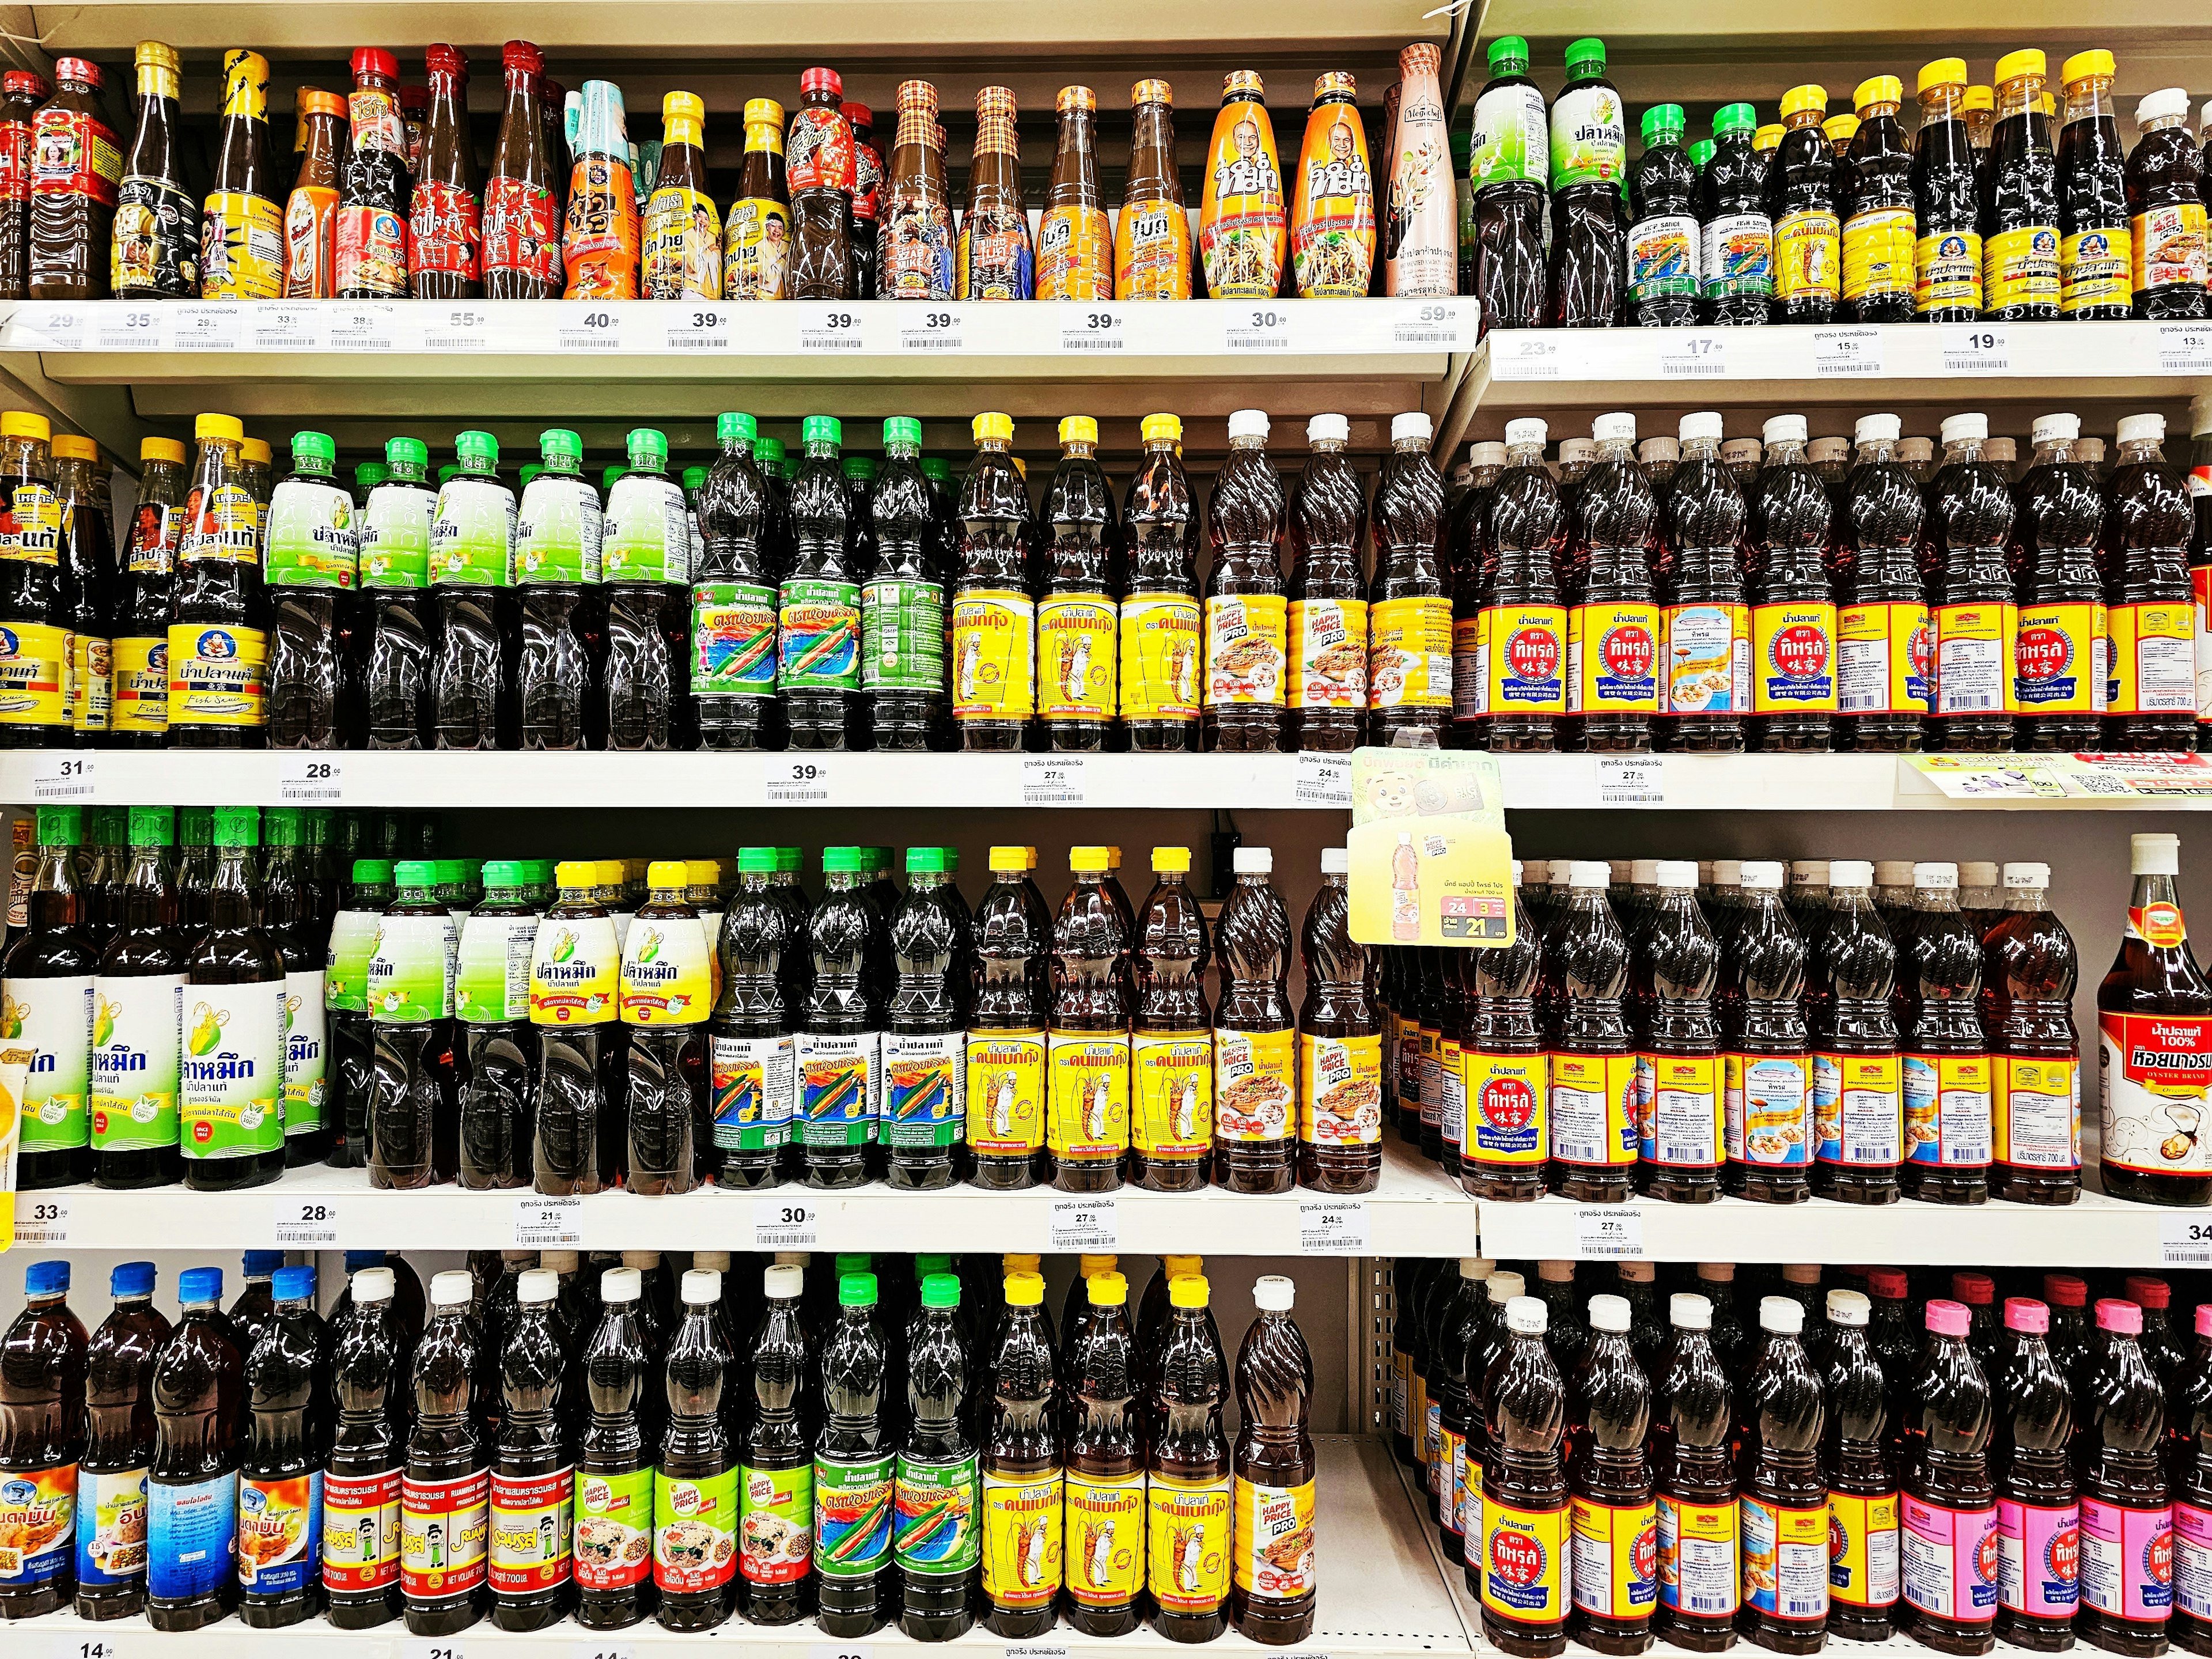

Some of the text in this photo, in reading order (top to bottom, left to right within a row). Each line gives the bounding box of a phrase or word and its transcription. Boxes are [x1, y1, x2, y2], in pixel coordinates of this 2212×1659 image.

[1407, 109, 1440, 119] Megachef
[1575, 124, 1624, 142] ปลาหมึก
[1258, 288, 1269, 297] 100%
[450, 313, 475, 326] 55
[1421, 306, 1445, 320] 59
[49, 314, 74, 327] 29
[127, 313, 150, 327] 35
[198, 319, 210, 327] 29
[584, 313, 609, 327] 40
[693, 313, 717, 327] 39
[827, 313, 851, 328] 39
[926, 314, 950, 327] 39
[1088, 314, 1112, 328] 39
[1252, 313, 1277, 327] 30
[1520, 342, 1546, 355] 23
[1687, 340, 1712, 354] 17
[1838, 342, 1851, 350] 15
[1970, 335, 1994, 349] 19
[16, 494, 54, 503] เหยาะ!
[215, 493, 251, 502] เหยาะ!
[1216, 609, 1241, 624] HAPPY
[1518, 615, 1553, 625] น้ำปลาแท้
[1613, 612, 1648, 623] น้ำปลาแท้
[1783, 612, 1820, 623] น้ำปลาแท้
[1049, 614, 1112, 634] คนแบกกุ้ง
[1218, 616, 1243, 633] PRICE
[1313, 621, 1341, 637] PRICE
[1224, 627, 1247, 642] PRO
[1625, 630, 1639, 638] ตรา
[2031, 631, 2046, 641] ตรา
[1516, 639, 1554, 658] ทิพรส
[1611, 638, 1650, 656] ทิพรส
[1781, 638, 1823, 656] ทิพรส
[180, 661, 255, 681] น้ำปลาแท้
[2177, 697, 2186, 706] 700
[61, 760, 83, 776] 31
[307, 764, 331, 778] 28
[793, 765, 816, 779] 39
[1448, 902, 1488, 914] 24 3
[1466, 918, 1486, 936] 21
[537, 960, 596, 979] ปลาหมึก
[623, 961, 677, 979] ปลาหมึก
[813, 1037, 857, 1050] น้ำปลาแท้
[2160, 1037, 2195, 1047] 100%
[976, 1049, 1038, 1066] คนแบกกุ้ง
[1070, 1051, 1126, 1068] คนแบกกุ้ง
[1320, 1052, 1342, 1065] HAPPY
[1231, 1064, 1252, 1075] PRO
[1490, 1064, 1527, 1074] น้ำปลาแท้
[1329, 1070, 1350, 1083] PRO
[1488, 1089, 1528, 1108] ทิพรส
[2048, 1153, 2058, 1162] 700
[521, 1200, 541, 1209] ถูกจริง
[1055, 1203, 1075, 1211] ถูกจริง
[1301, 1204, 1321, 1212] ถูกจริง
[35, 1205, 58, 1219] 33
[302, 1206, 325, 1221] 28
[782, 1208, 805, 1222] 30
[1580, 1210, 1601, 1218] ถูกจริง
[2190, 1226, 2212, 1240] 34
[450, 1483, 476, 1498] RUAMROS
[585, 1485, 607, 1498] HAPPY
[749, 1480, 770, 1493] HAPPY
[751, 1487, 771, 1499] PRICE
[176, 1495, 212, 1506] ผสมไอโอดีน
[456, 1495, 475, 1506] PRODUCE
[501, 1498, 543, 1506] ผลิตจากปลาไส้ตัน
[586, 1493, 608, 1505] PRICE
[673, 1489, 697, 1502] HAPPY
[674, 1497, 699, 1510] PRICE
[1074, 1495, 1138, 1513] คนแบกกุ้ง
[1162, 1499, 1224, 1516] คนแบกกุ้ง
[1263, 1503, 1290, 1516] HAPPY
[1264, 1510, 1291, 1524] PRICE
[1272, 1520, 1296, 1535] PRO
[492, 1527, 537, 1549] รวมรส
[1497, 1538, 1536, 1565] ทิพรส
[578, 1567, 592, 1580] ไอโอดีน
[744, 1562, 758, 1574] ไอโอดีน
[330, 1571, 340, 1580] 700
[448, 1575, 457, 1584] NET
[506, 1574, 520, 1582] 700
[665, 1573, 684, 1584] ไอโอดีน
[81, 1643, 103, 1658] 14
[430, 1650, 452, 1659] 21
